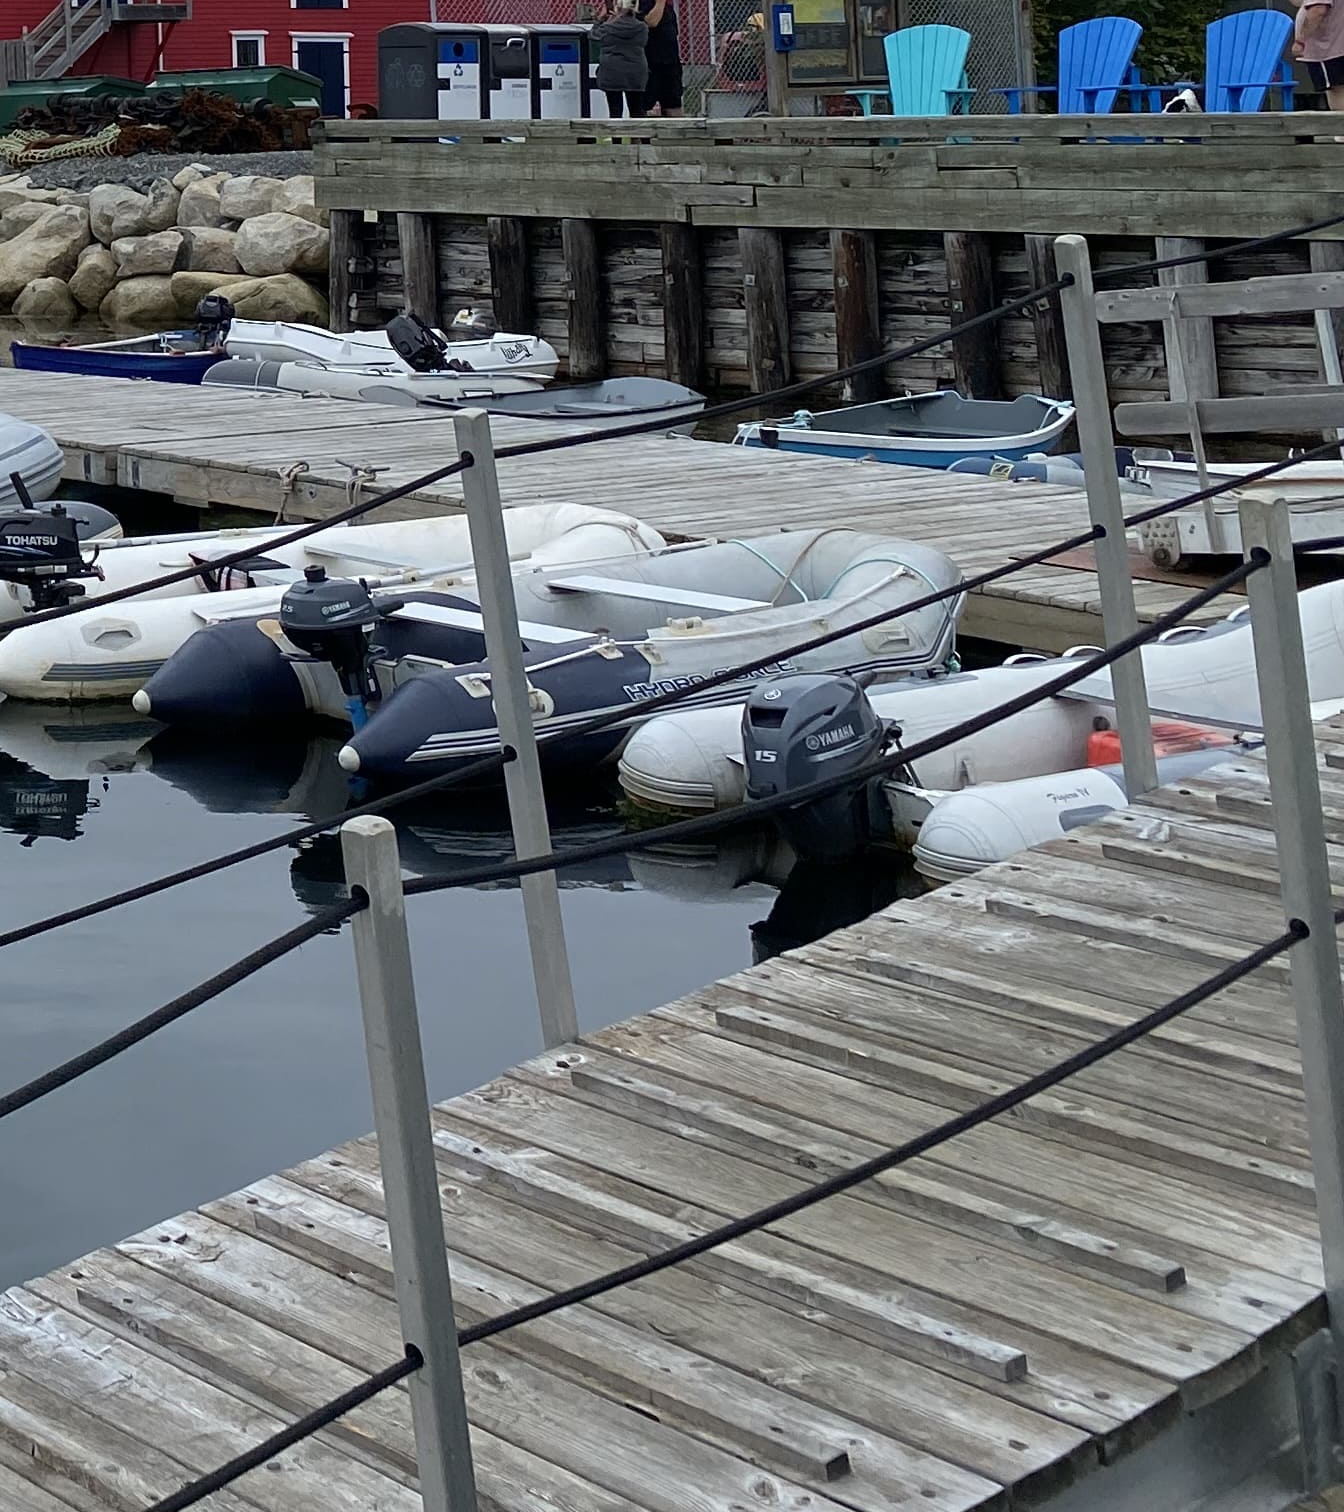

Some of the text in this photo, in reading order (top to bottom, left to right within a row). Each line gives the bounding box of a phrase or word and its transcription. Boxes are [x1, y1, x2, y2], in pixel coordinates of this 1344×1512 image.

[4, 535, 58, 546] TOHATSU
[328, 600, 351, 612] YAMAHA
[818, 724, 856, 748] YAMAHA
[754, 750, 778, 763] 15
